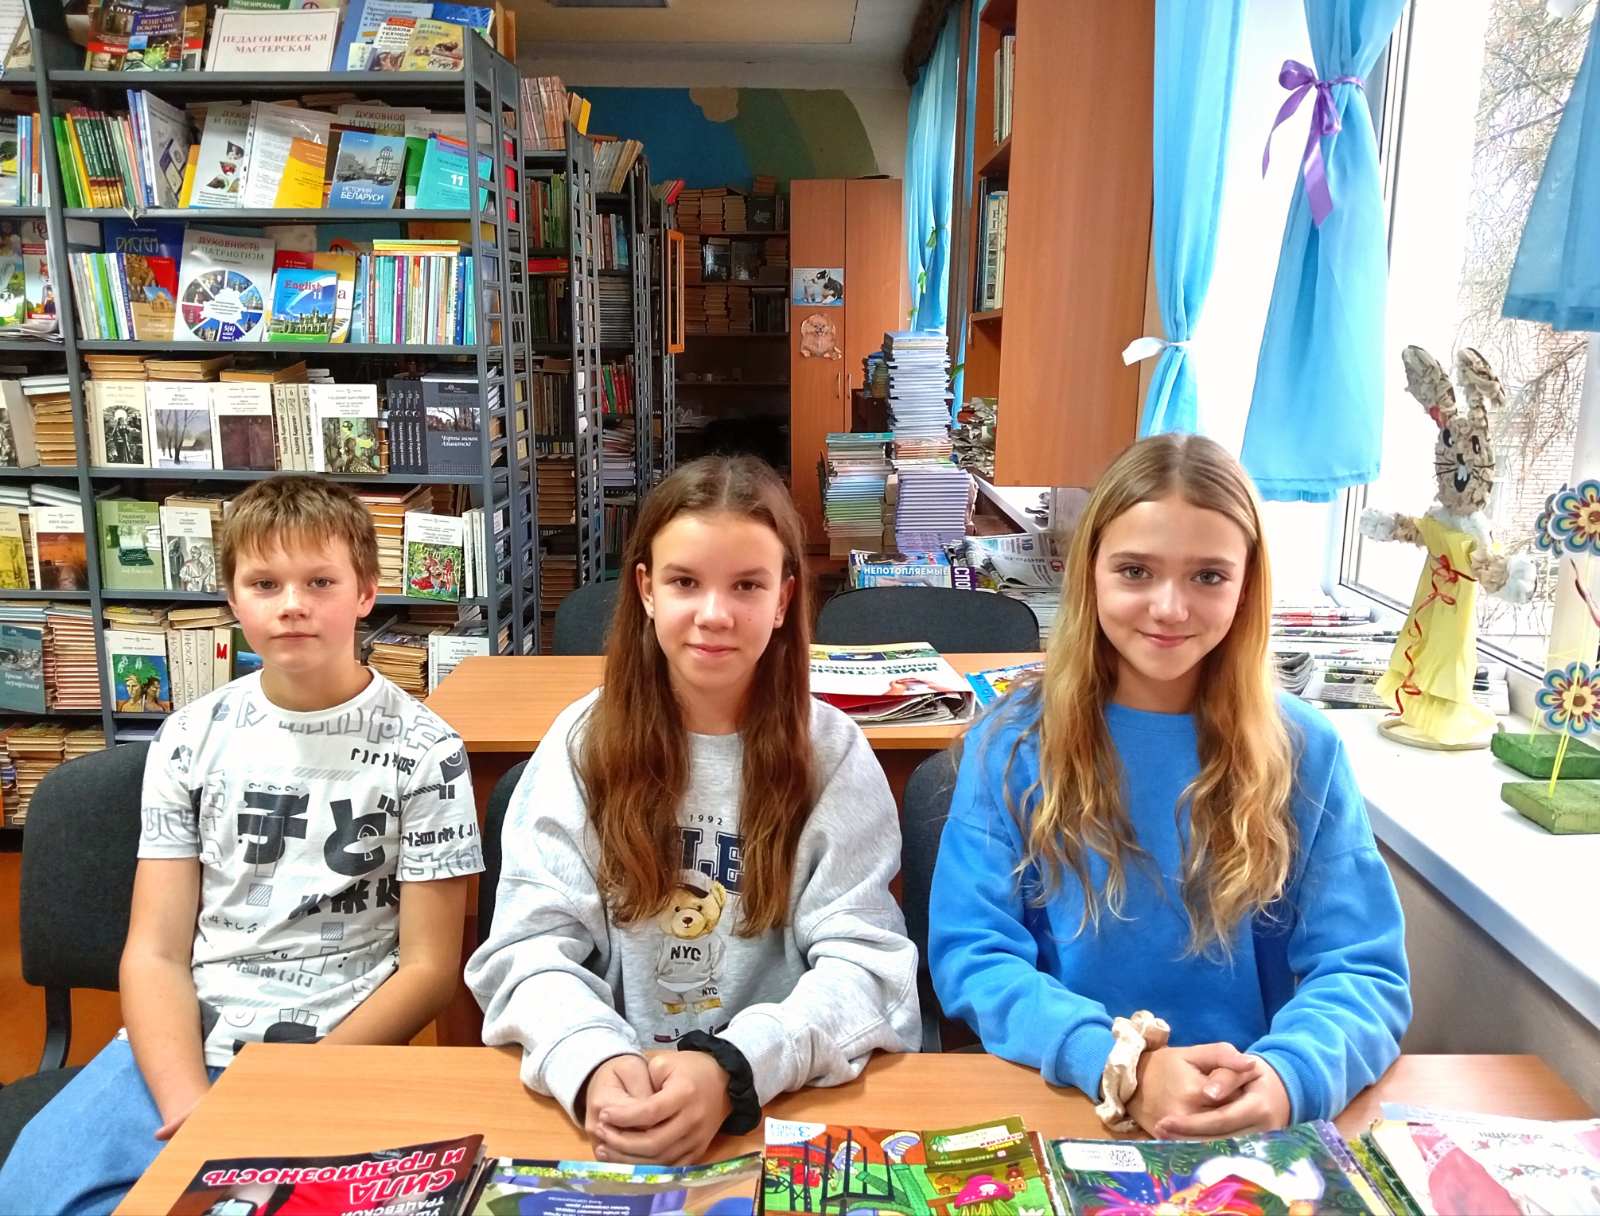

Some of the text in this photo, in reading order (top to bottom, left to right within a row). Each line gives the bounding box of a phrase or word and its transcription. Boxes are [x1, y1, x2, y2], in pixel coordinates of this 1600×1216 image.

[222, 33, 328, 43] ПЕДАГОГИЧЕСКАЯ
[235, 44, 312, 53] МАСТЕРСКАЯ
[450, 174, 464, 186] 11
[340, 191, 384, 201] БЕЛАРУСИ
[199, 236, 260, 250] ДУХОВНОСТЬ
[284, 280, 322, 291] English
[313, 291, 322, 299] 11
[689, 814, 723, 826] 1992
[670, 946, 702, 962] NYC
[702, 986, 718, 996] NYC
[350, 1169, 456, 1205] СИЛА
